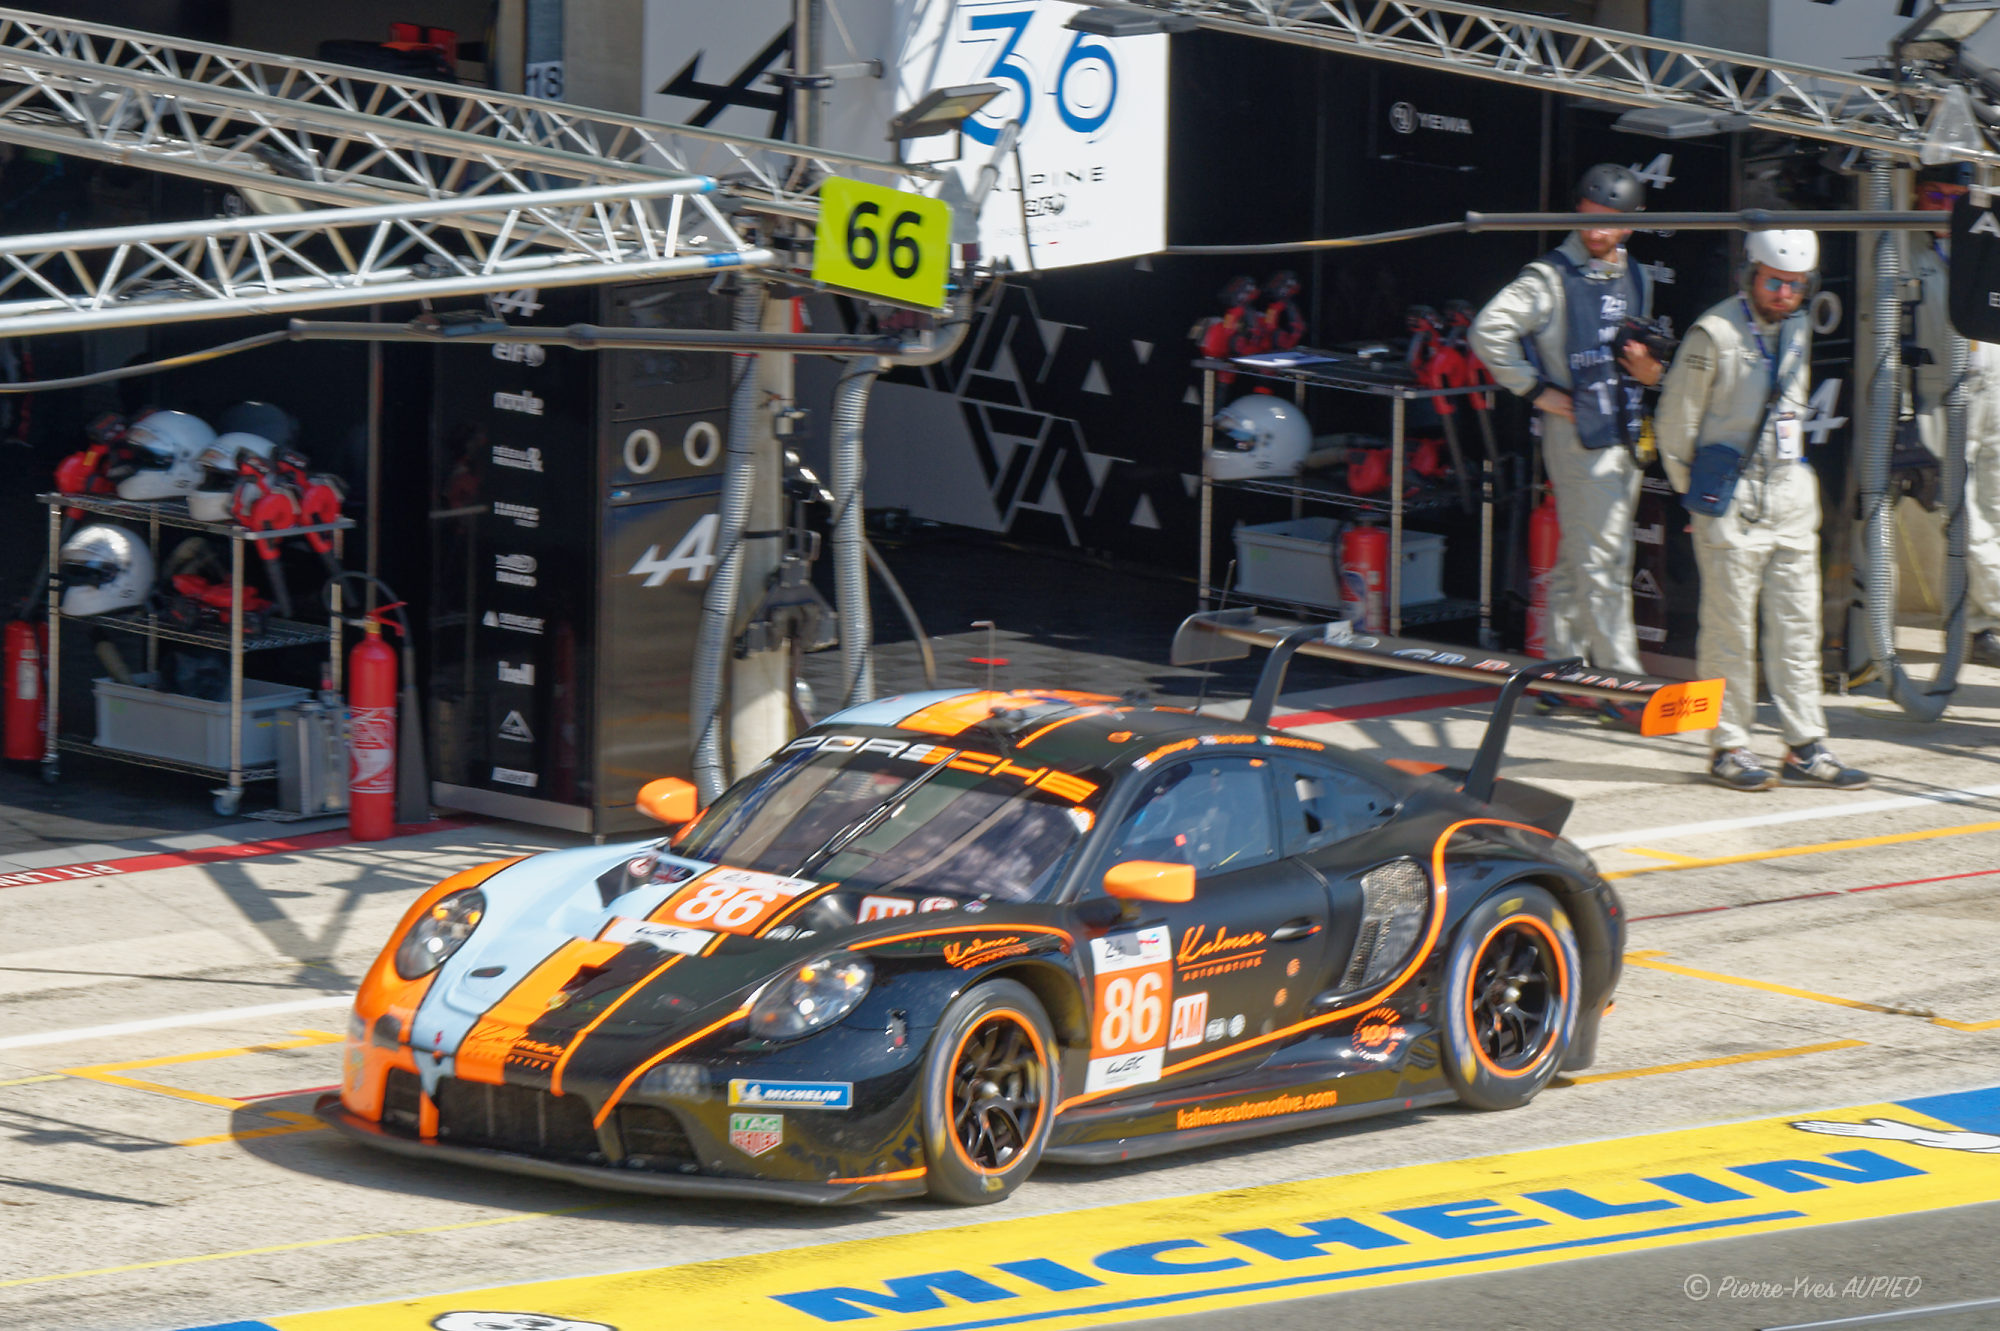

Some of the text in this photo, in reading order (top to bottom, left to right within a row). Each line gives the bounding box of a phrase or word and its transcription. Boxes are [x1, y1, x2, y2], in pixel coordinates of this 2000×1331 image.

[962, 10, 1119, 147] 36
[847, 201, 922, 280] 66
[778, 735, 1099, 804] PORSCHE
[675, 884, 778, 928] 86
[1176, 925, 1267, 965] Kalmar
[1100, 971, 1164, 1051] 86
[764, 1089, 843, 1101] MICHELIN
[1177, 1090, 1338, 1131] kalmarautomotive.com
[766, 1149, 1932, 1323] MICHELIN
